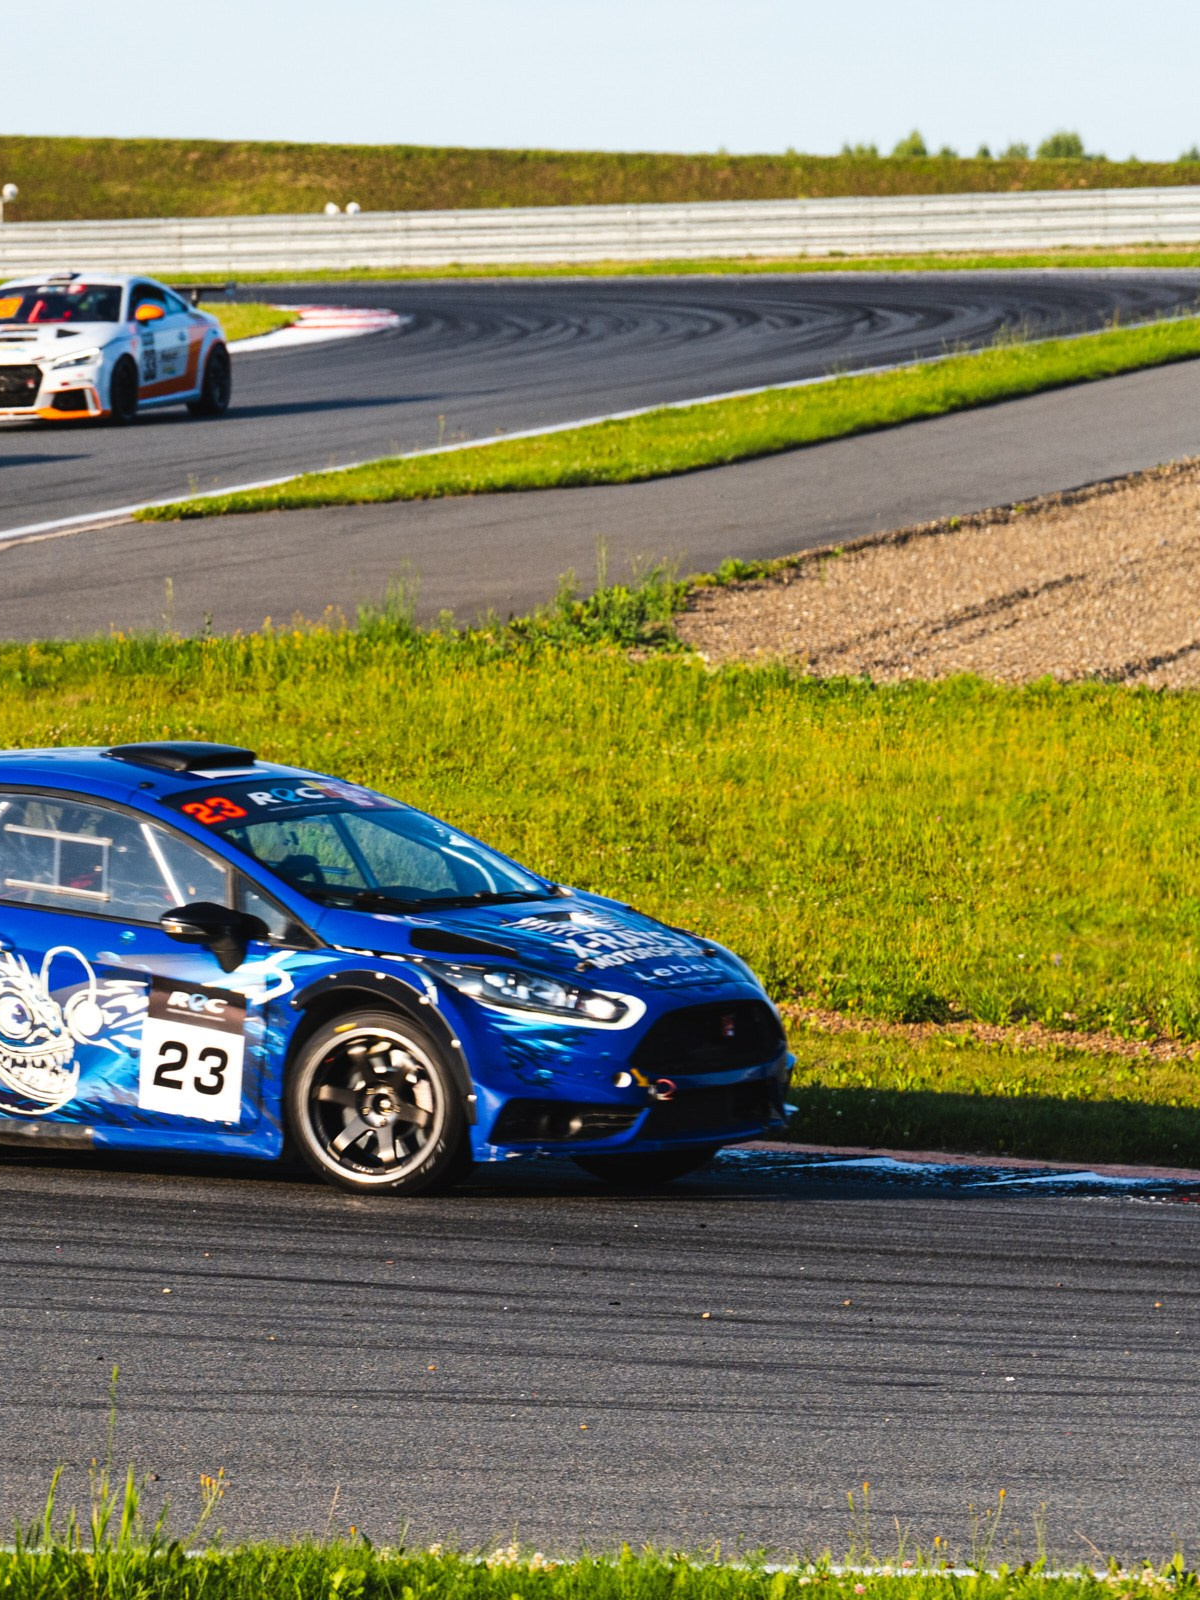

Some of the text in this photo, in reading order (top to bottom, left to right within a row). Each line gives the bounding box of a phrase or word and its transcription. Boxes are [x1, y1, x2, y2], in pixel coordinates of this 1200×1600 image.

[181, 797, 247, 824] 23
[553, 928, 688, 959] X-RAYS
[153, 1040, 228, 1095] 23
